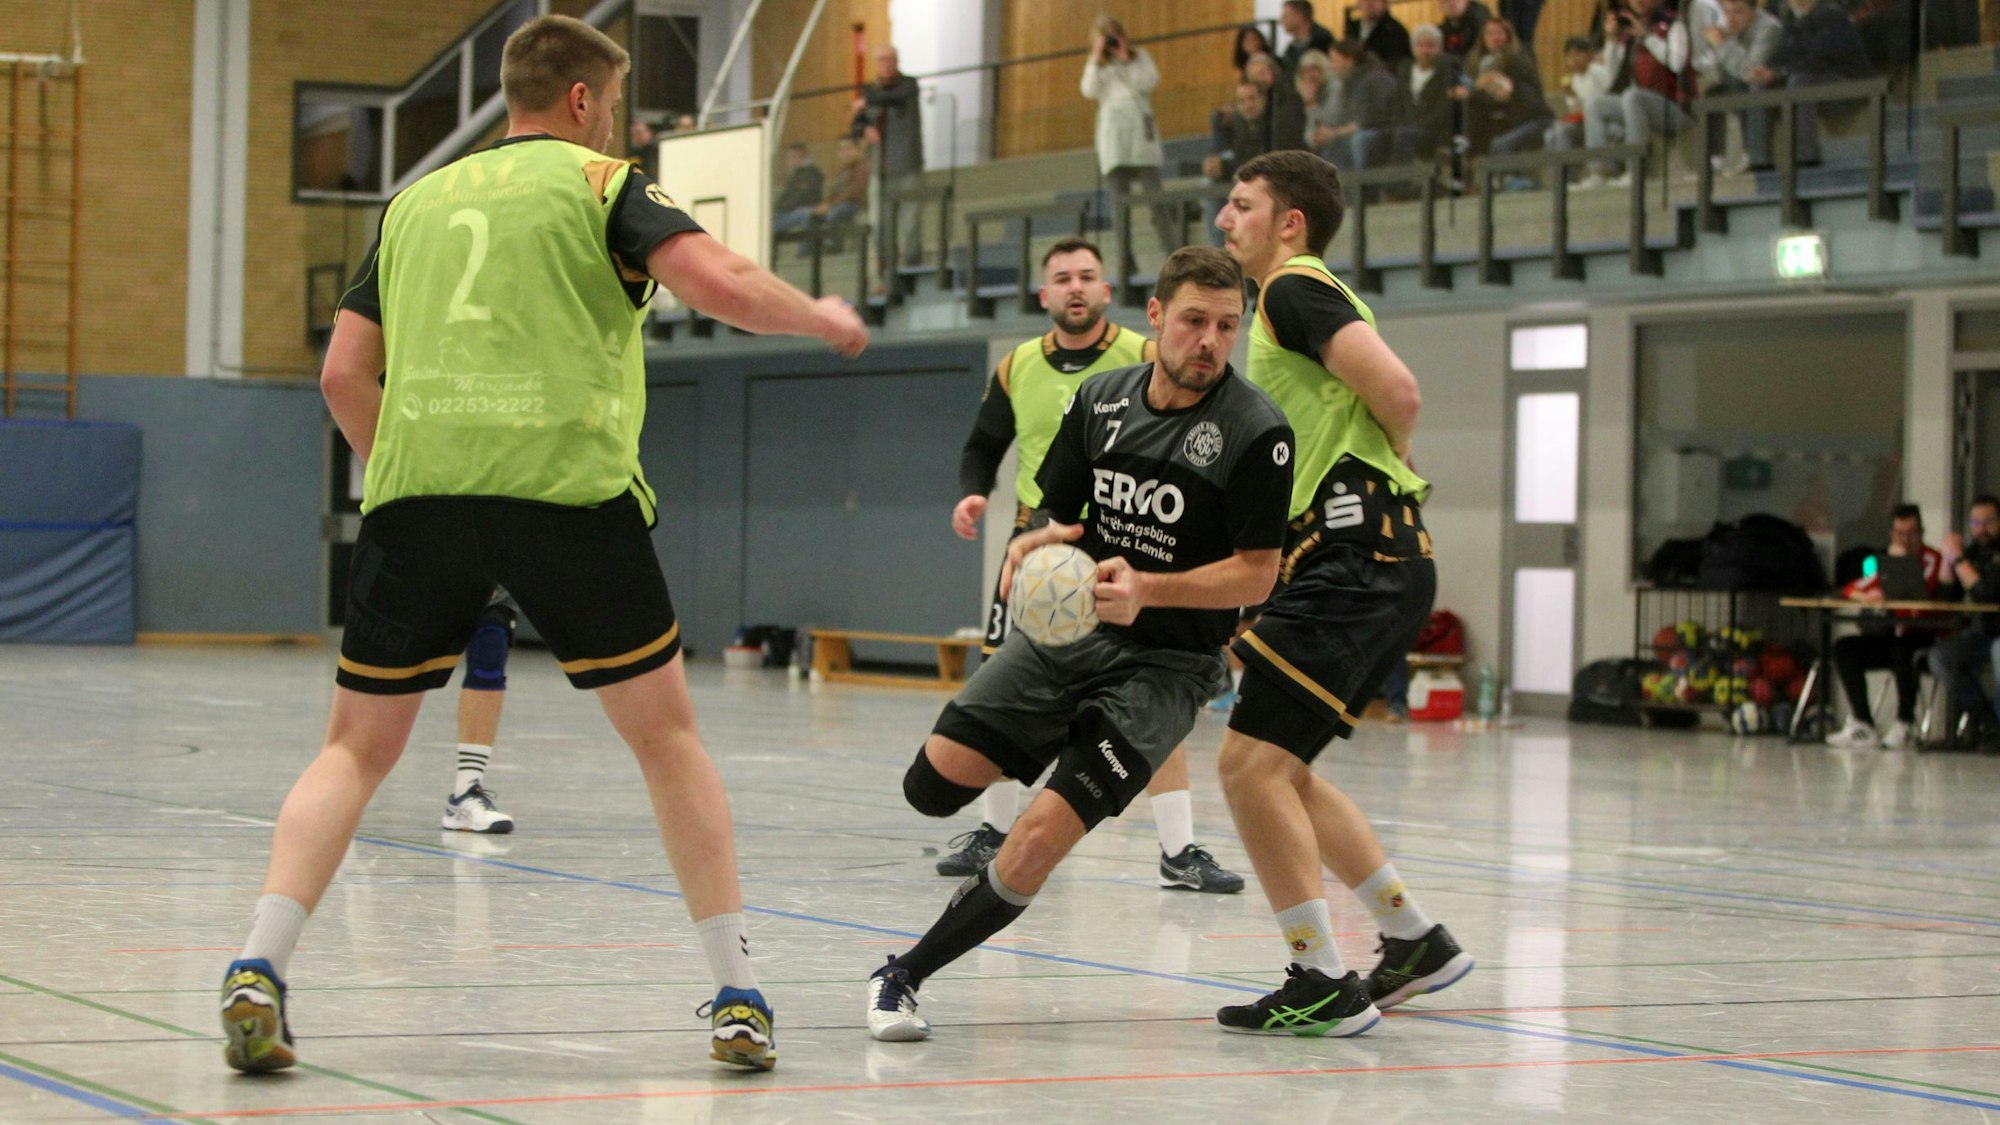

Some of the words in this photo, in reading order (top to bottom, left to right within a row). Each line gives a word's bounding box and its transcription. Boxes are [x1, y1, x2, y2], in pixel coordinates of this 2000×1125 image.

[445, 208, 492, 324] 2
[428, 396, 545, 414] 02253-2222
[1104, 419, 1122, 453] 7
[1193, 433, 1214, 456] HSC
[1093, 468, 1184, 524] ERGO
[1121, 536, 1131, 548] &
[1134, 538, 1174, 563] Lemke
[1098, 739, 1129, 780] Kempa
[1075, 771, 1103, 799] JAKO
